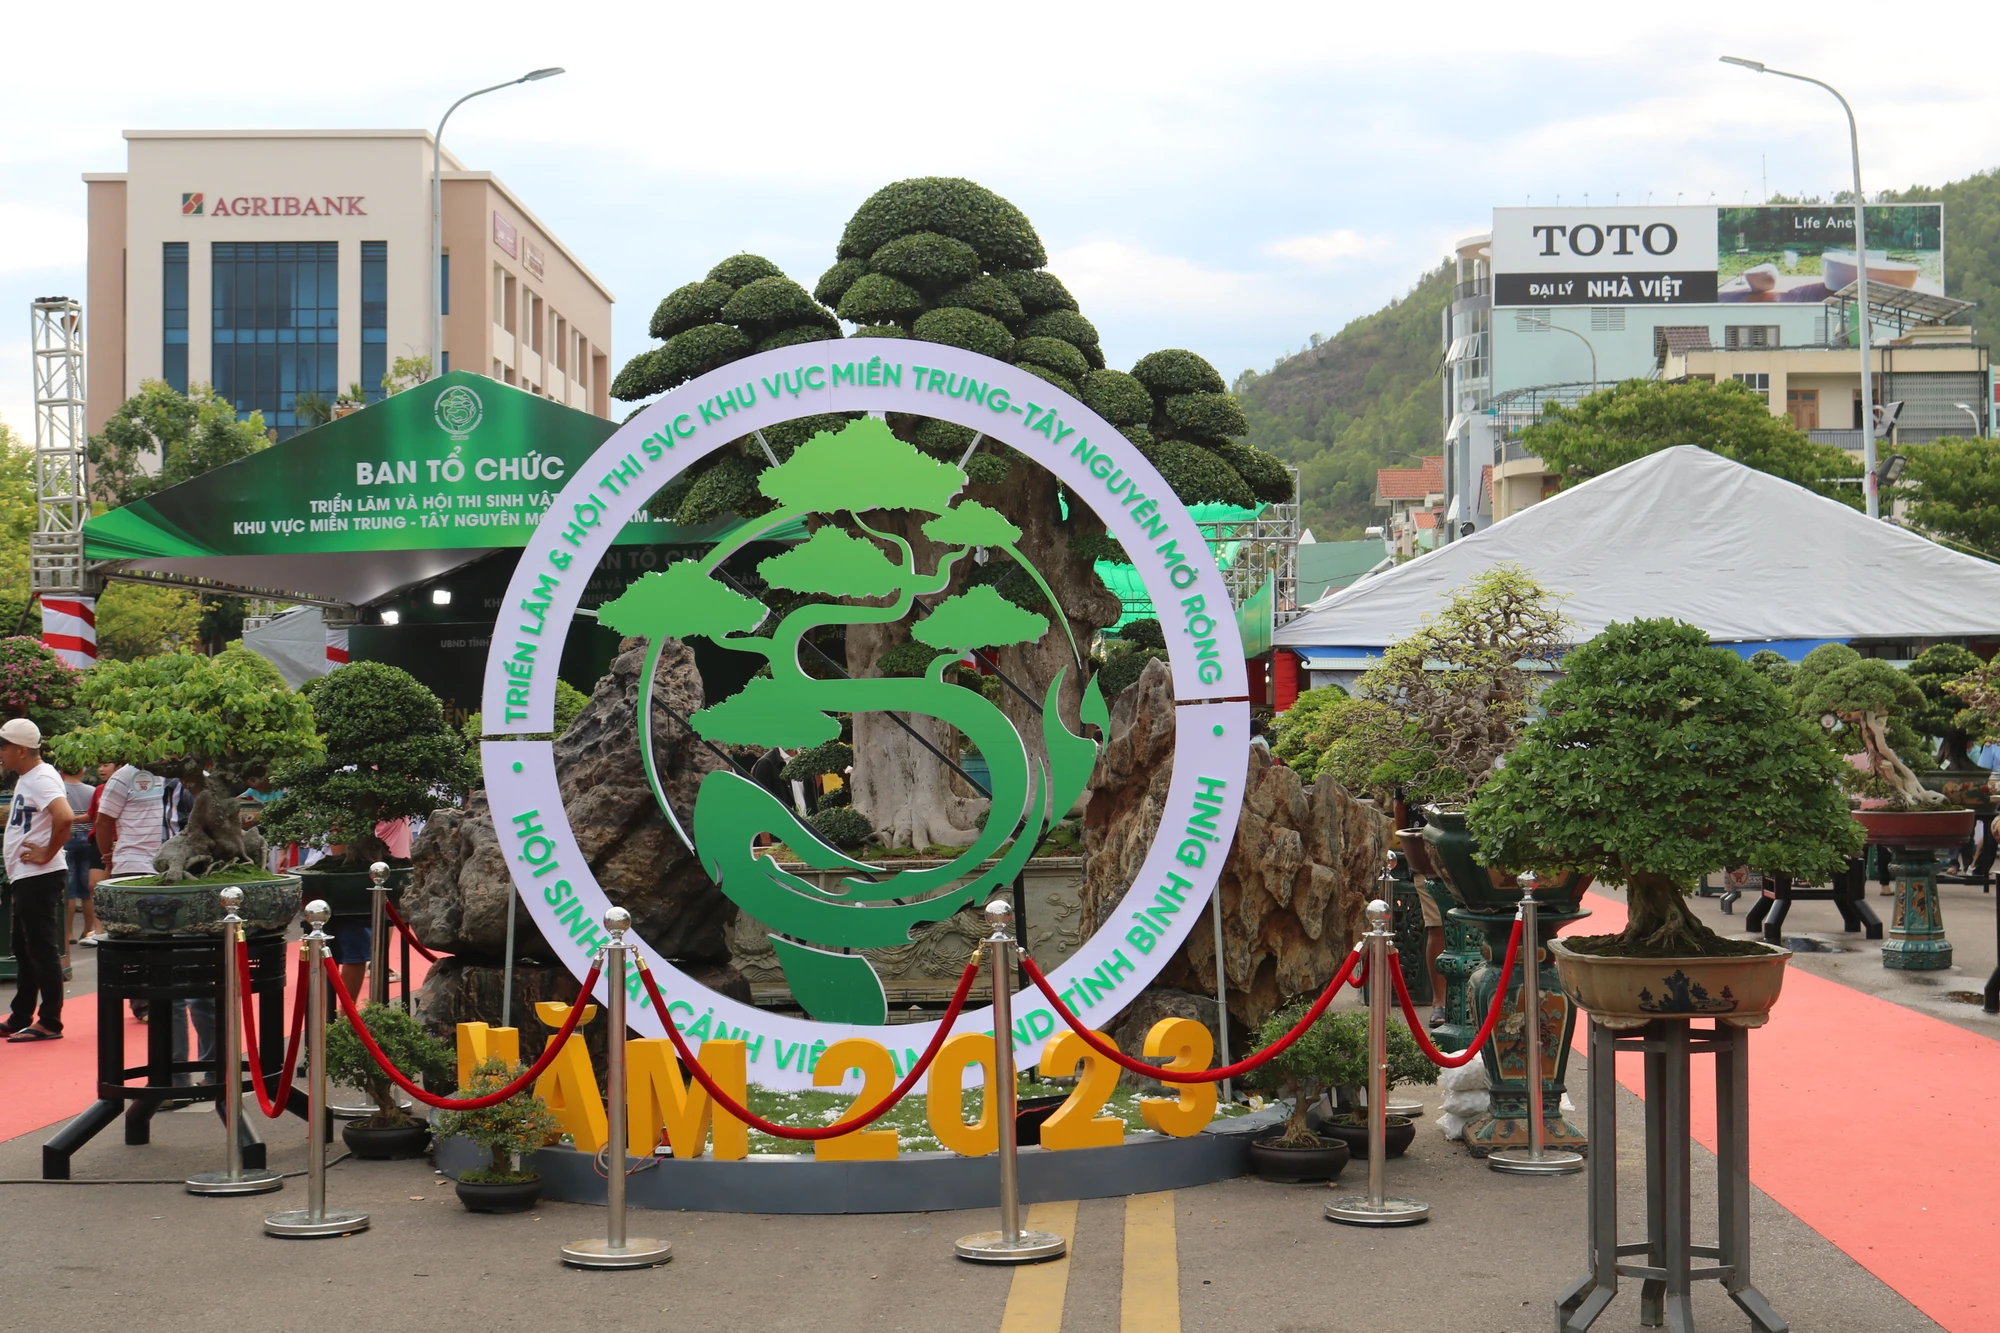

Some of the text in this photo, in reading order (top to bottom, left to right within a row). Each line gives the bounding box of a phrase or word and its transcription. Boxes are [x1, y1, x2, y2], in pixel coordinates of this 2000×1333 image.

[211, 196, 368, 217] AGRIBANK
[1794, 216, 1820, 229] Life
[1533, 222, 1678, 257] TOTO
[1529, 274, 1683, 302] ĐẠI LÝ NHÀ VIỆT
[356, 445, 565, 486] BAN TỔ CHỨC
[309, 492, 353, 513] TRIỂN
[395, 493, 418, 510] VÀ
[422, 492, 452, 512] HỘI
[456, 495, 481, 508] THI
[485, 494, 523, 508] SINH
[233, 521, 266, 535] KHU
[270, 518, 305, 537] VỰC
[310, 512, 348, 532] MIỀN
[352, 516, 407, 530] TRUNG
[420, 511, 449, 528] TÂY
[454, 510, 520, 527] NGUYÊN
[520, 573, 560, 636] LÃM
[549, 548, 573, 571] &
[561, 493, 608, 547] HỘI
[598, 453, 644, 495] THI
[641, 414, 696, 461] SVC
[697, 382, 757, 426] KHU
[761, 366, 826, 399] VỰC
[1070, 436, 1169, 540] NGUYÊN
[1155, 538, 1199, 589] MỞ
[1180, 593, 1223, 685] RỘNG
[440, 639, 466, 648] UBND
[512, 809, 560, 878] HỘI
[543, 879, 610, 958] SINH
[1059, 948, 1136, 1017] TỈNH
[1125, 871, 1194, 955] BÌNH
[1175, 776, 1227, 868] ĐỊNH
[813, 1017, 1218, 1161] 2023
